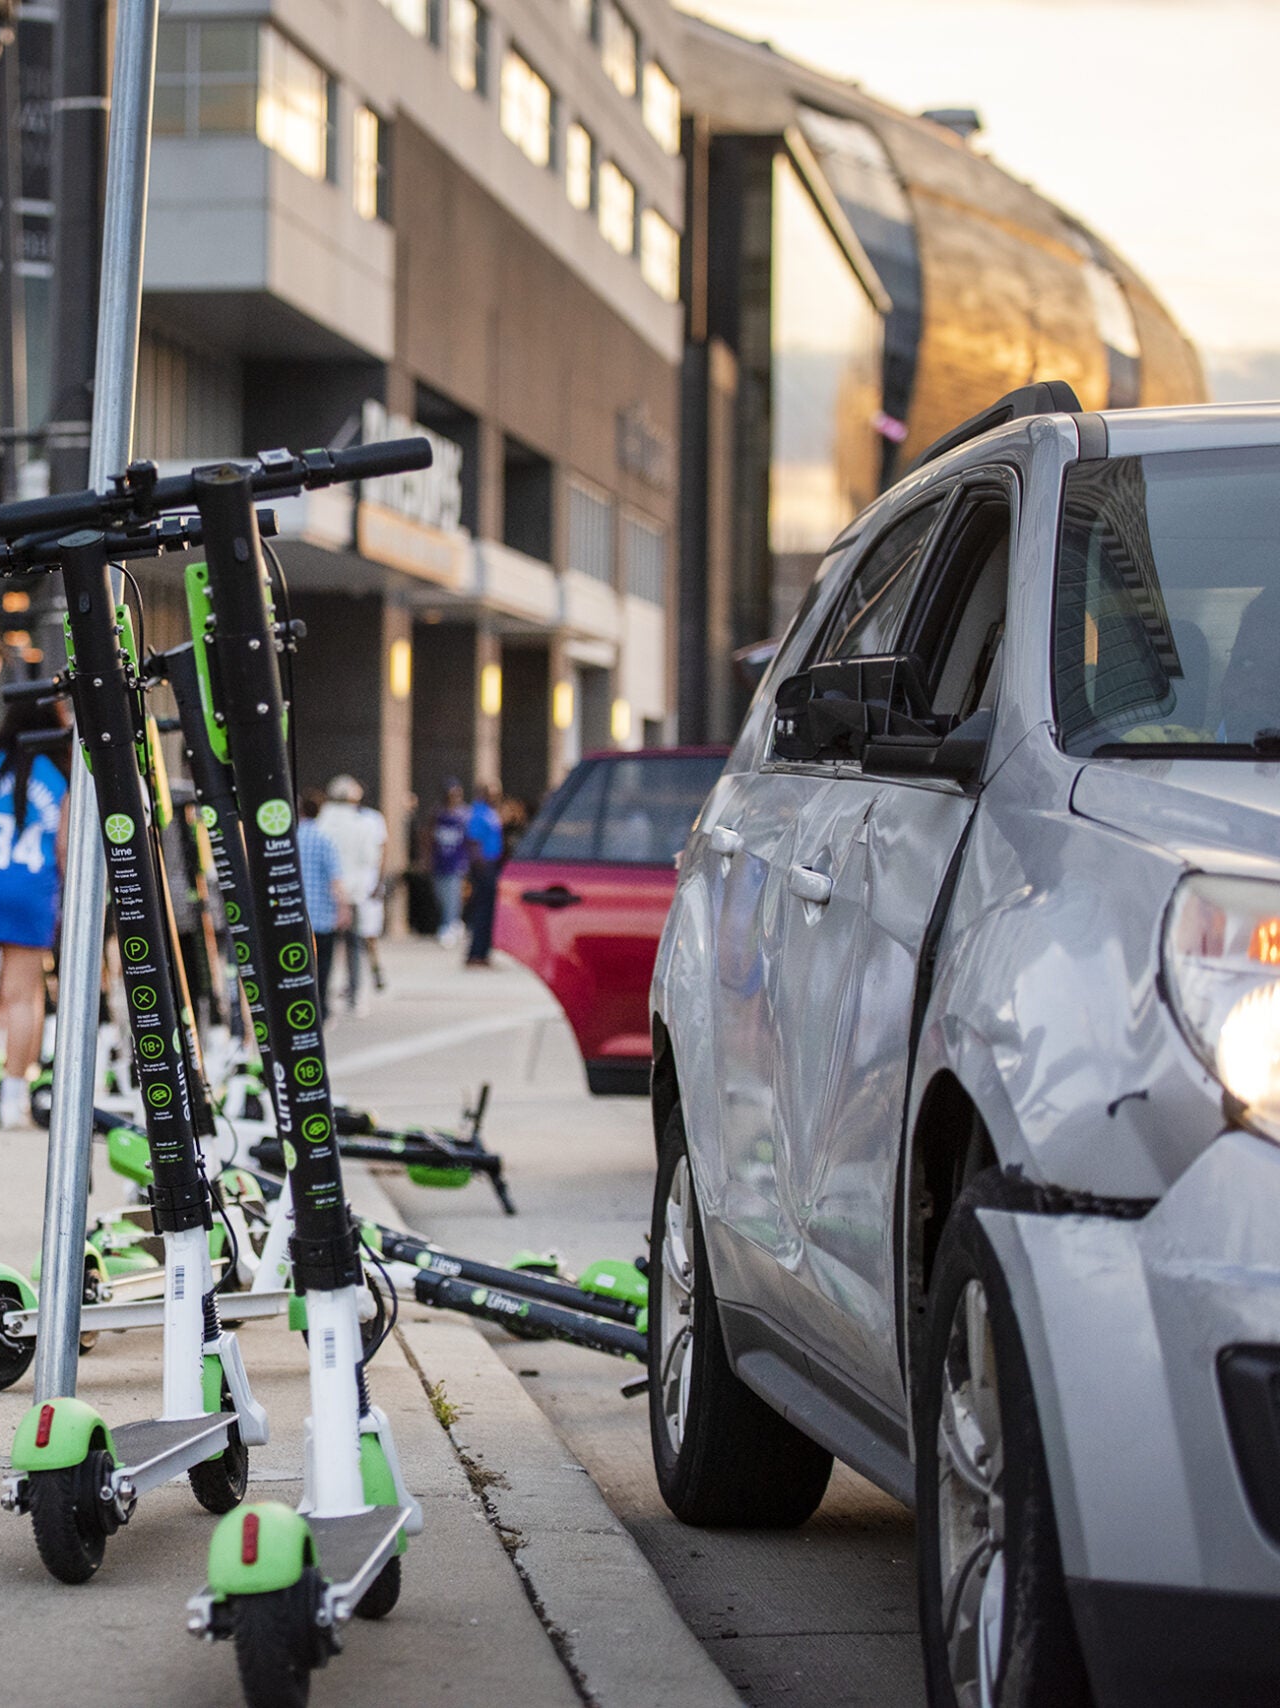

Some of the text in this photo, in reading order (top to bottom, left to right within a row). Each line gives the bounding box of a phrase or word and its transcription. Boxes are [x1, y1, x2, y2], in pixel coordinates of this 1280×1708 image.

[111, 847, 132, 857] Lime
[265, 839, 291, 851] Lime
[130, 942, 141, 956] P
[288, 949, 301, 966] P
[143, 1041, 160, 1053] 18+
[300, 1065, 319, 1079] 18+
[273, 1061, 292, 1133] Lime
[431, 1254, 462, 1277] Lime
